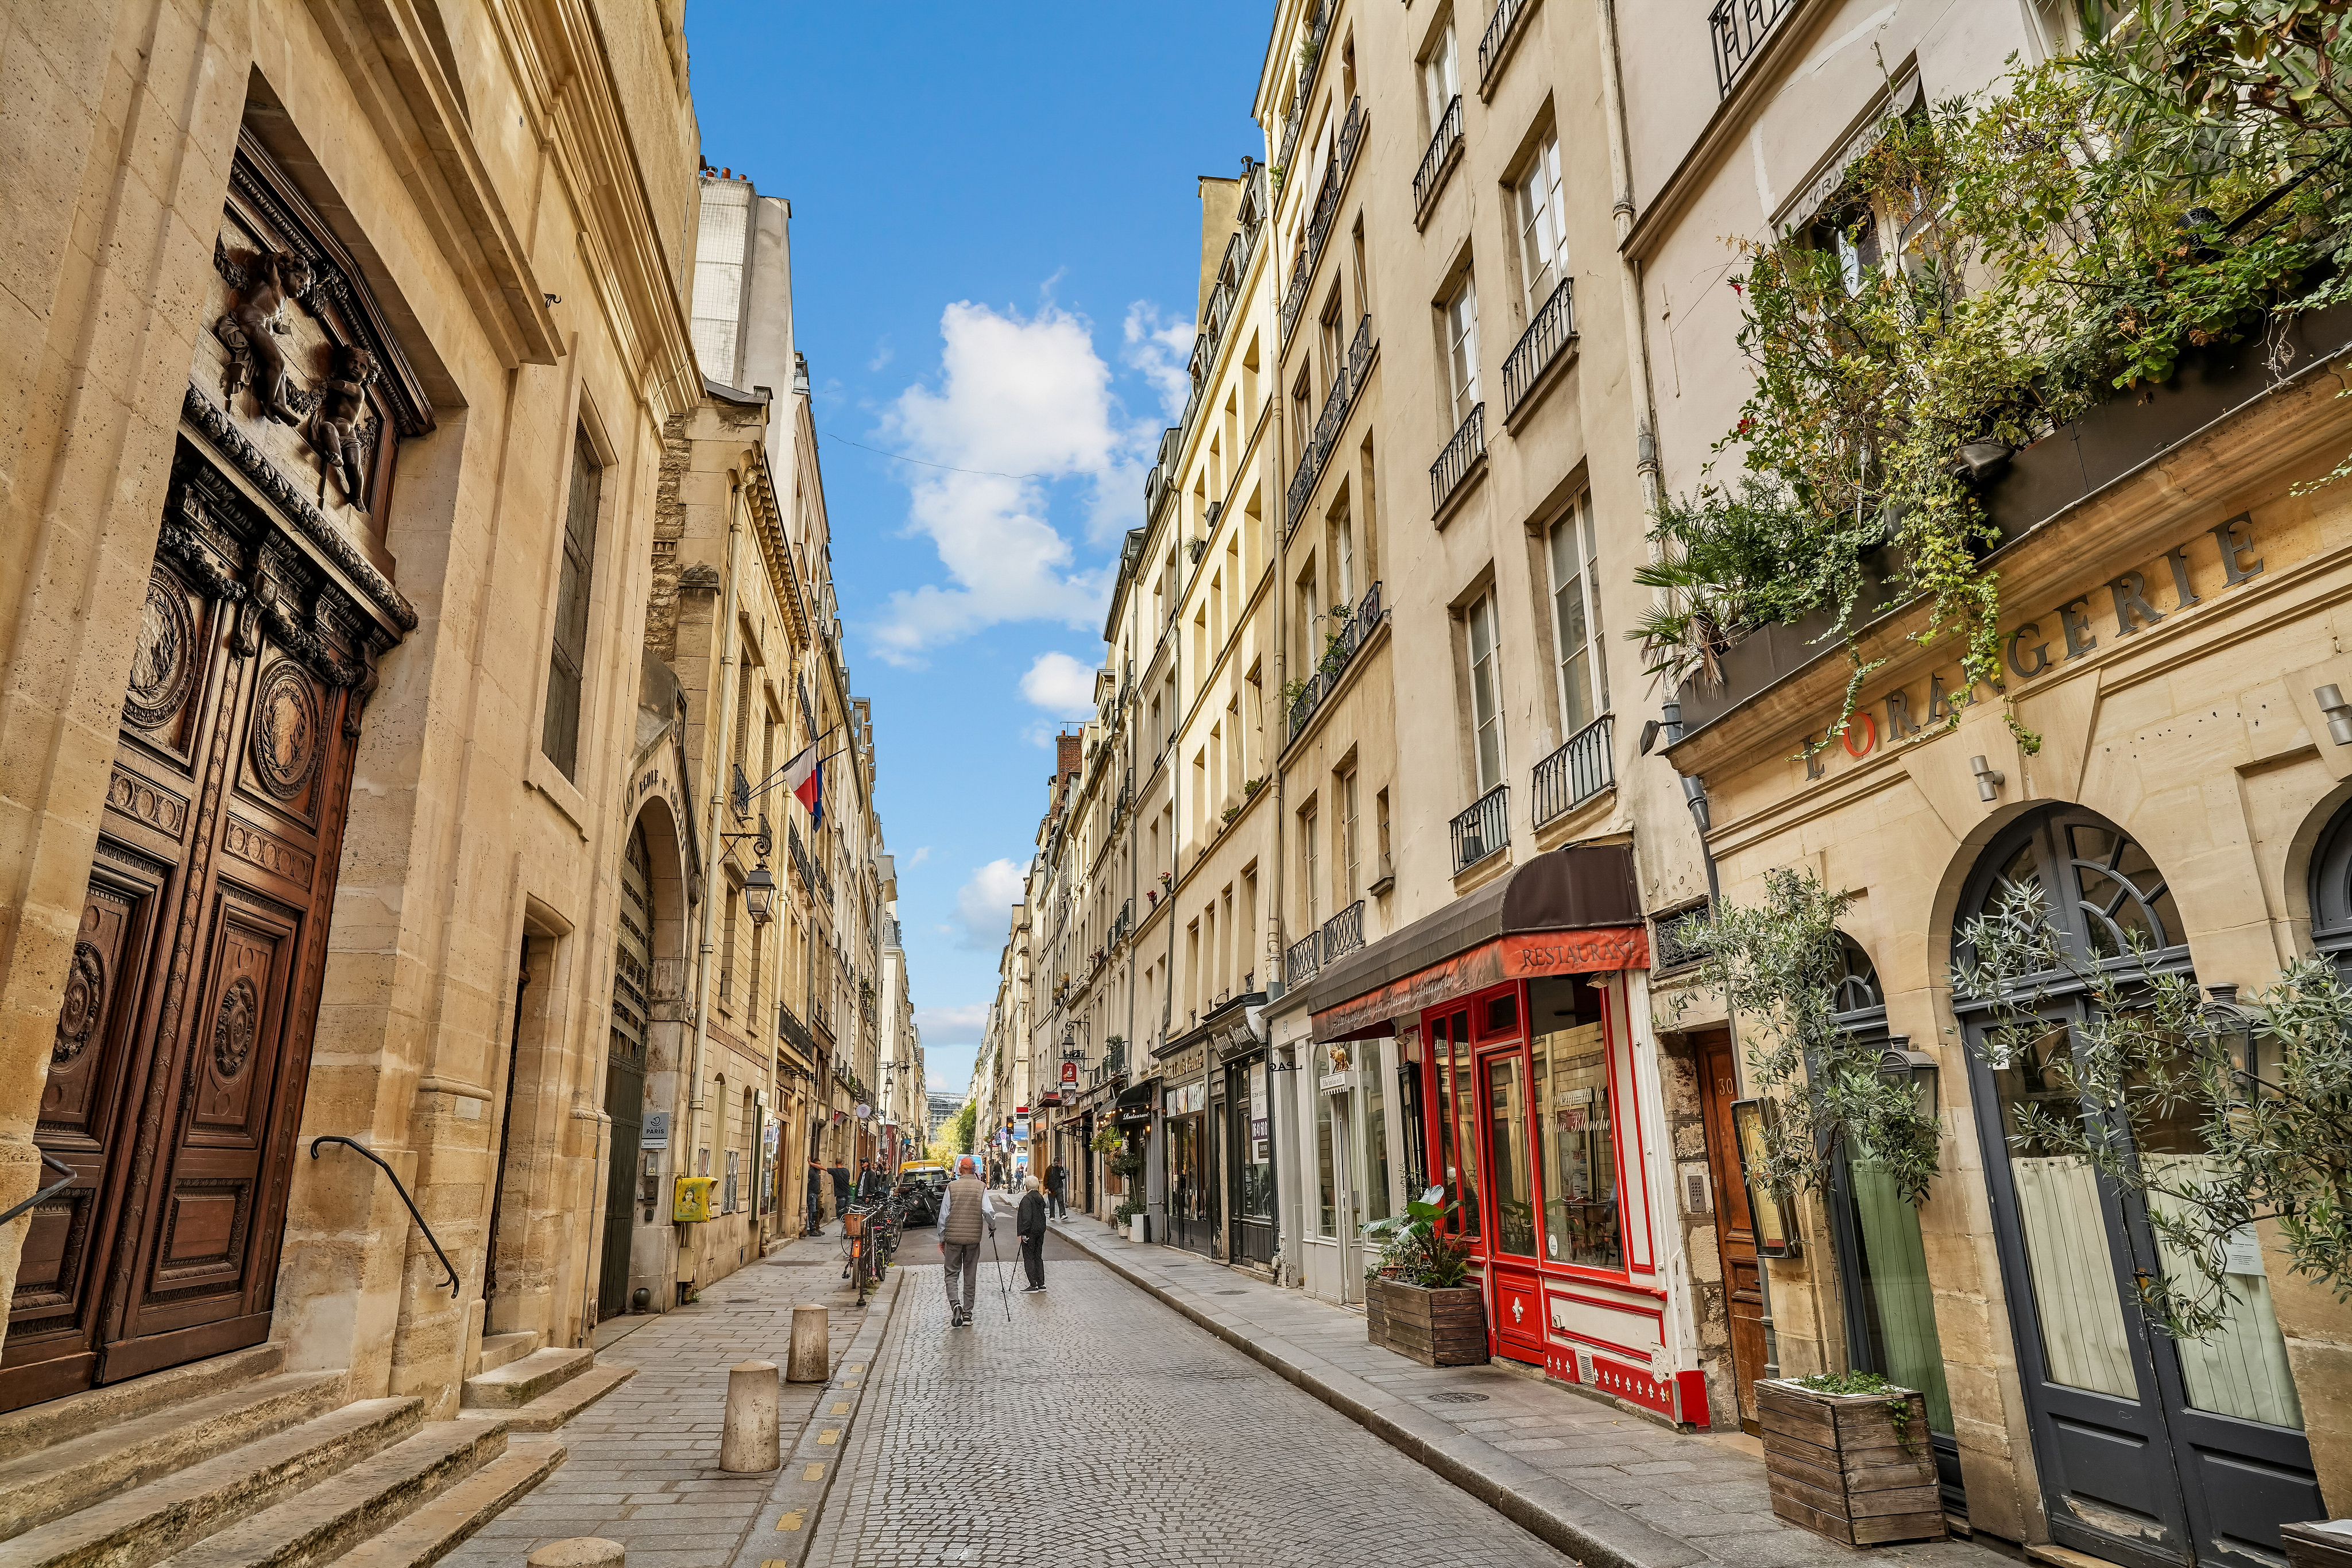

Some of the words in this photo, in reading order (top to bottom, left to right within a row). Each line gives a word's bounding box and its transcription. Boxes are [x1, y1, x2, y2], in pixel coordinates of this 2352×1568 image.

[1800, 510, 2264, 781] LORAGERIE
[1522, 941, 1634, 967] RESTAURANT
[1333, 1008, 1360, 1028] Auberge
[1388, 986, 1411, 1008] Reine
[1416, 973, 1455, 997] Blanche
[1174, 1058, 1186, 1078] Louis
[1186, 1050, 1204, 1074] Beauté
[1581, 1085, 1591, 1102] de
[1595, 1082, 1605, 1102] la
[1719, 1077, 1734, 1095] 30
[1123, 1112, 1150, 1120] Restaurant
[1571, 1110, 1611, 1132] Blanche
